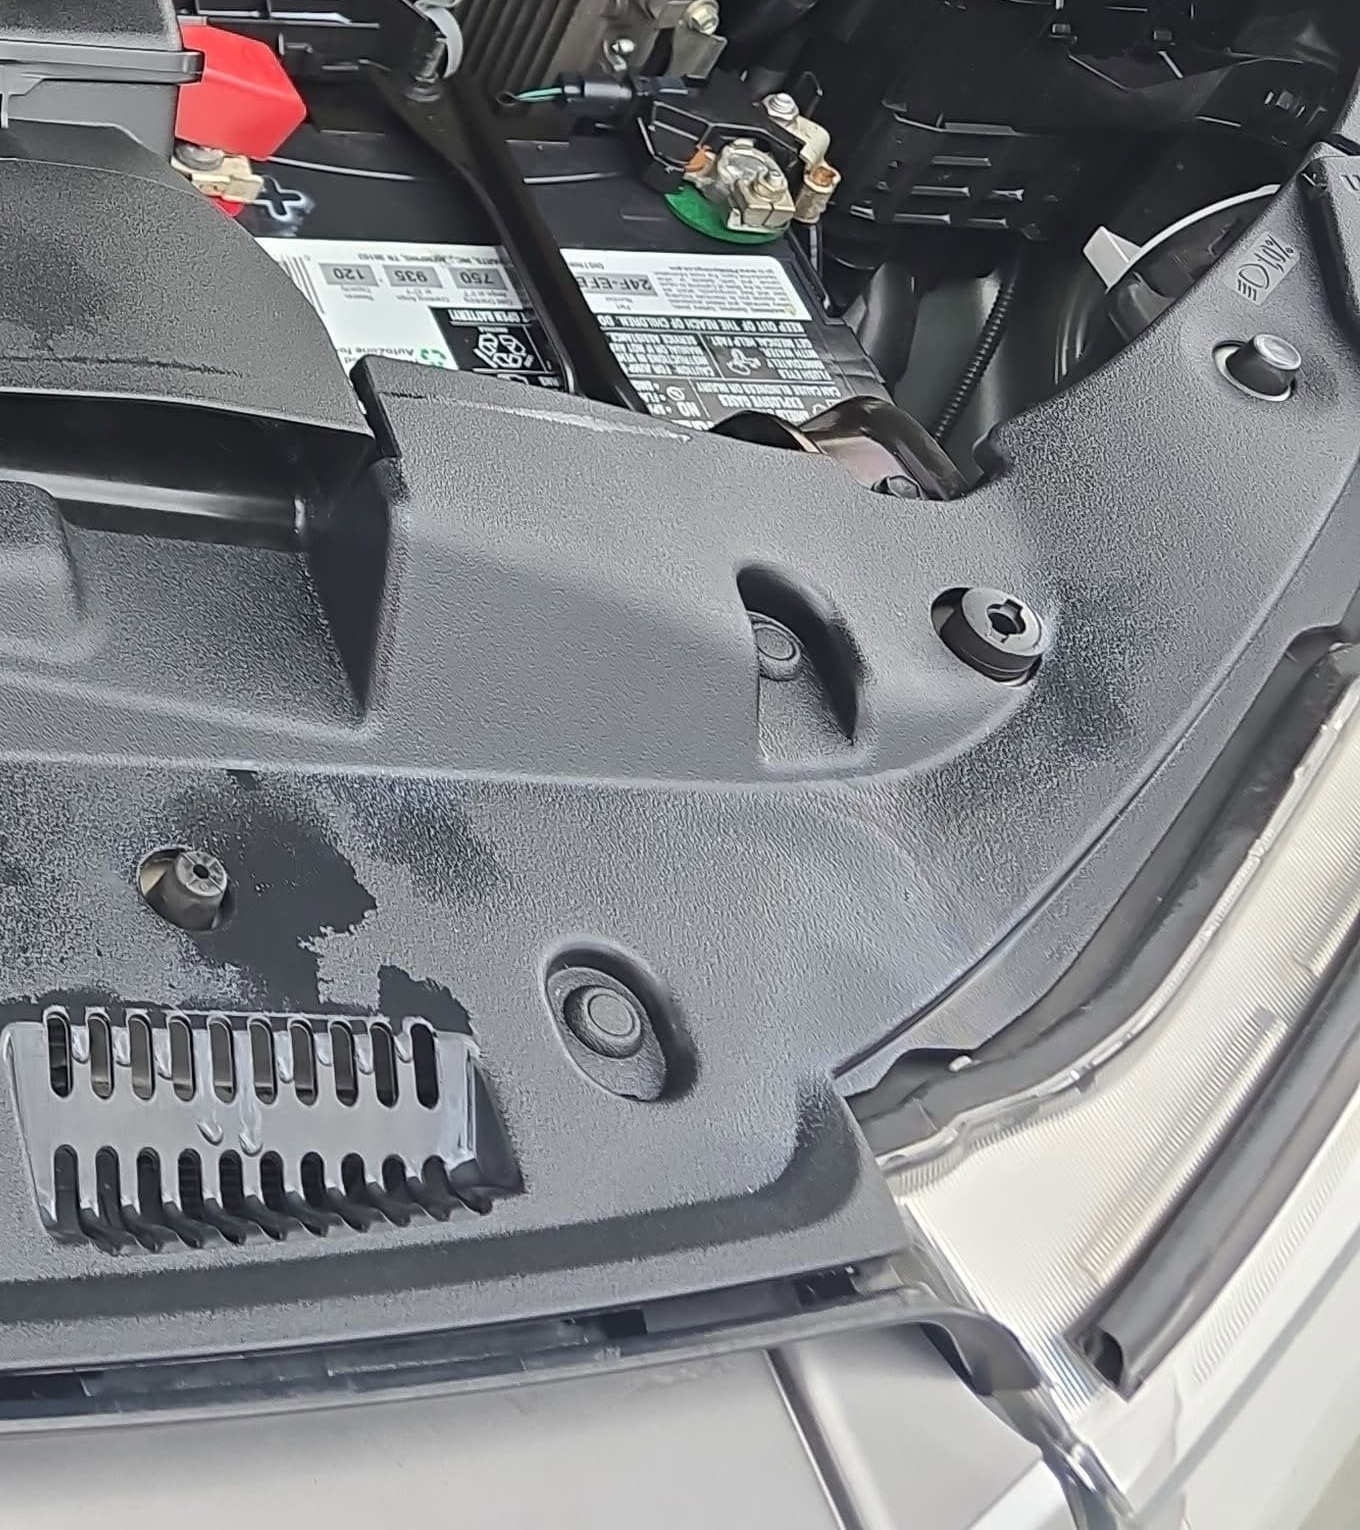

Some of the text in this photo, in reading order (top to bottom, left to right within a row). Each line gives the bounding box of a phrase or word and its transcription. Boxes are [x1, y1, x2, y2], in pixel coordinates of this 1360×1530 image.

[332, 268, 364, 280] 120
[394, 269, 428, 282] 935
[459, 271, 493, 284] 750
[668, 317, 685, 330] OF
[685, 318, 718, 331] REACH
[717, 319, 740, 332] THE
[739, 320, 755, 332] OF
[755, 320, 778, 332] OUT
[778, 321, 804, 333] KEEP
[355, 347, 414, 356] AutoZone
[800, 369, 831, 380] FLUSH
[791, 384, 821, 396] CAUSE
[820, 385, 841, 397] CAN
[750, 396, 805, 409] EXPLOSIVE
[676, 401, 701, 417] NO
